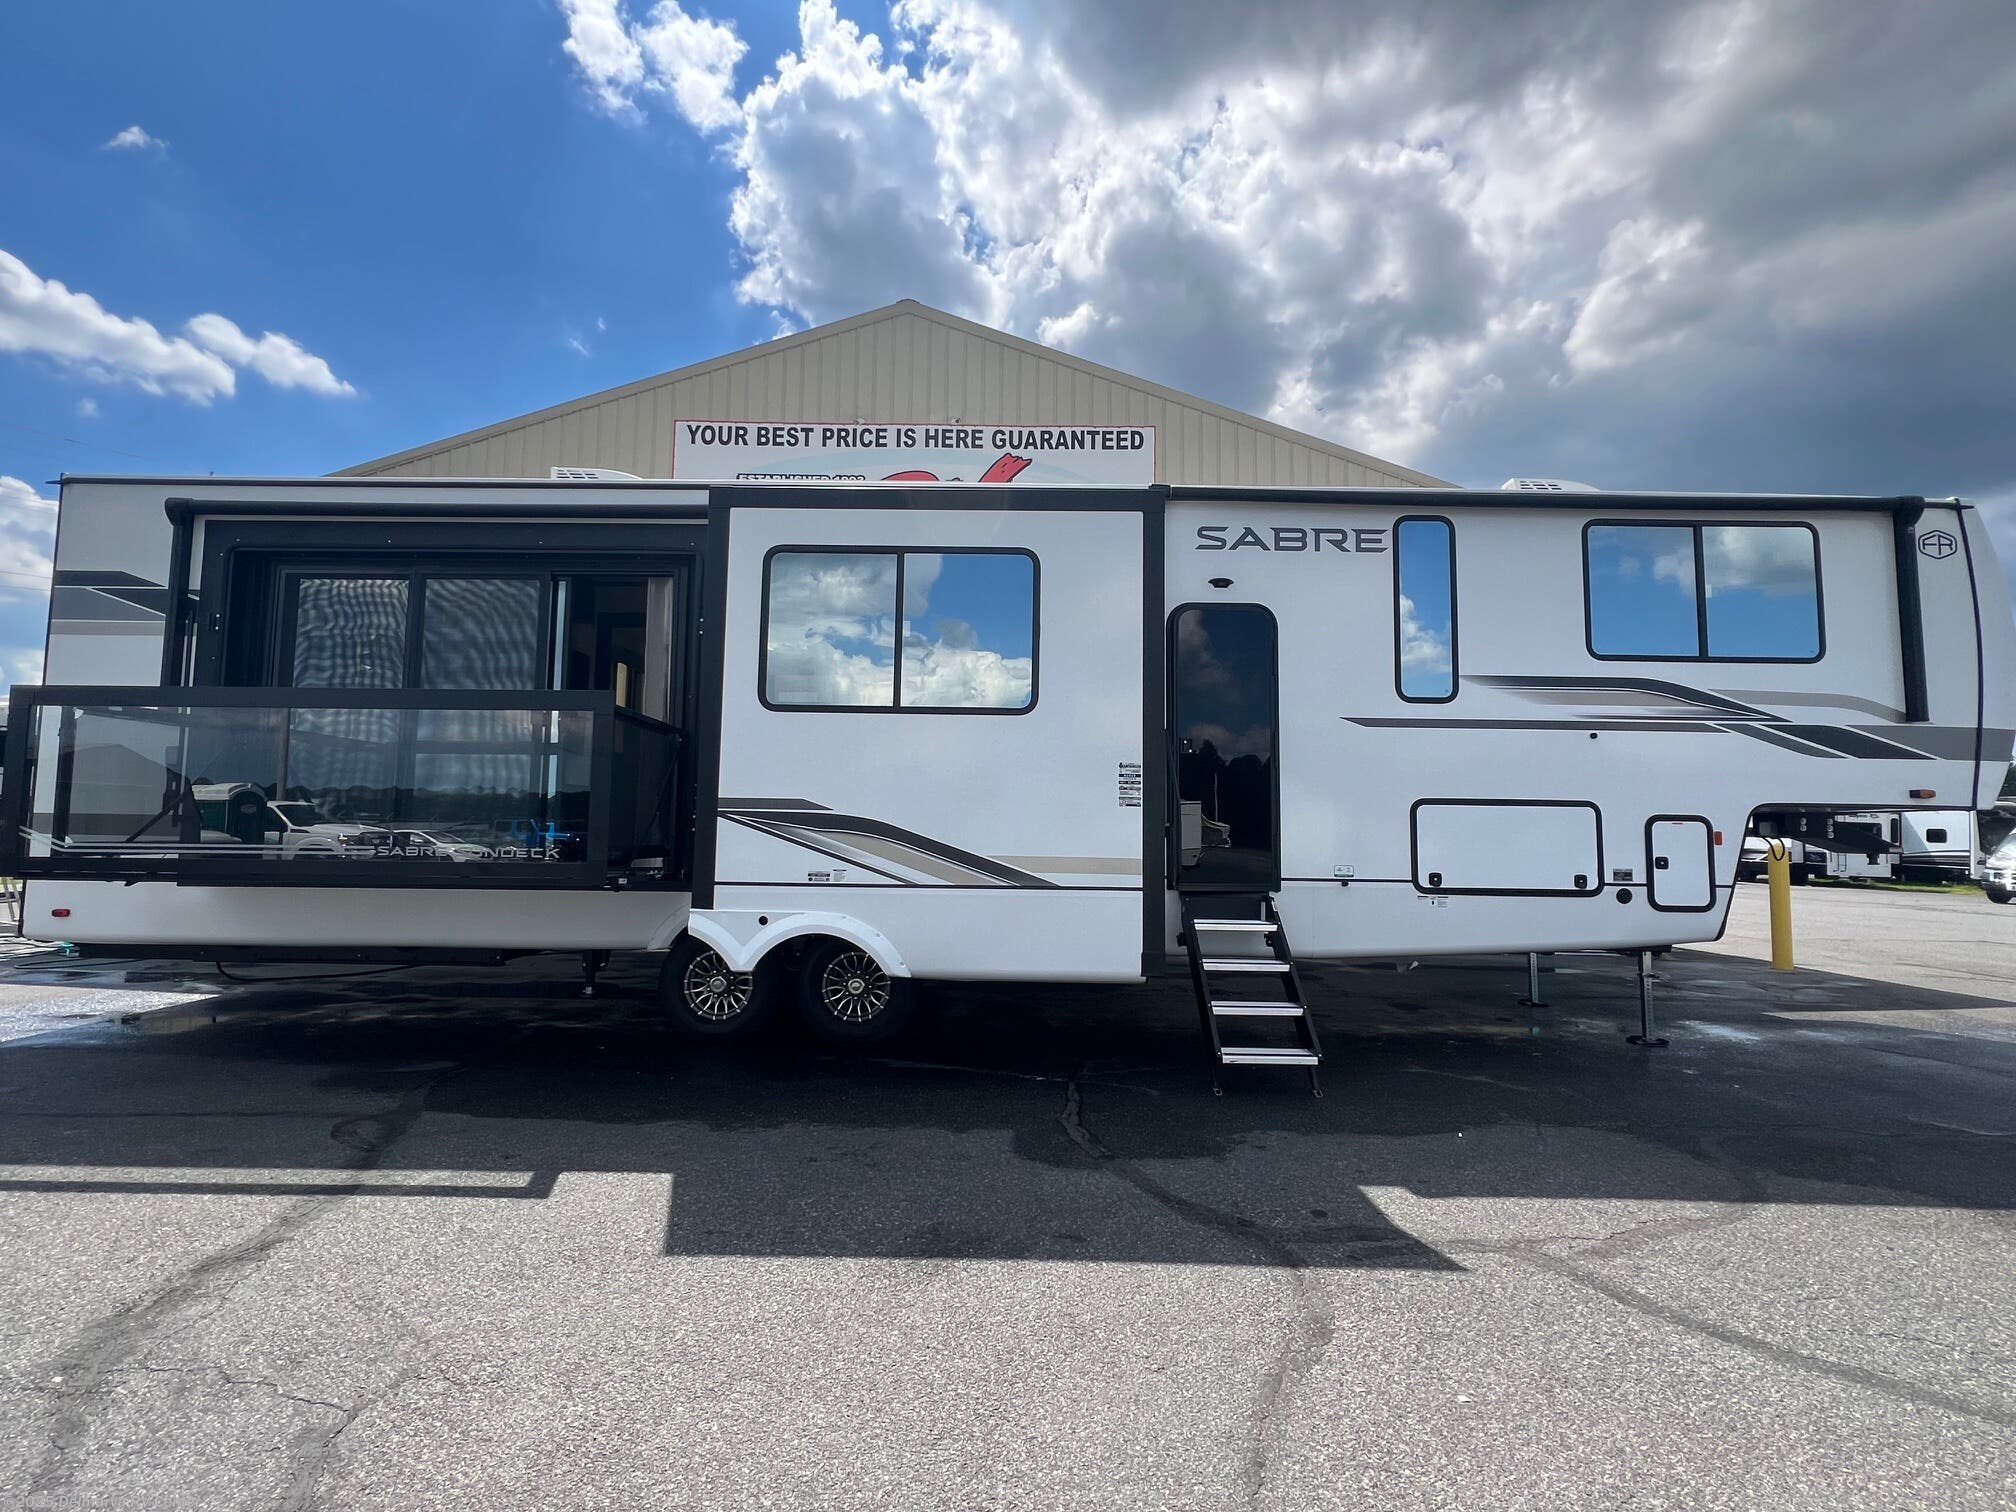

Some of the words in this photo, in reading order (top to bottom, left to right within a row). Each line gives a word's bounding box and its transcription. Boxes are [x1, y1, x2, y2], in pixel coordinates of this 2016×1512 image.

[687, 425, 748, 446] YOUR
[757, 426, 814, 447] BEST
[822, 428, 887, 448] PRICE
[896, 428, 917, 448] IS
[925, 428, 984, 449] HERE
[992, 429, 1144, 450] GUARANTEED
[1195, 526, 1389, 553] SABRE
[377, 846, 447, 857] SABRE
